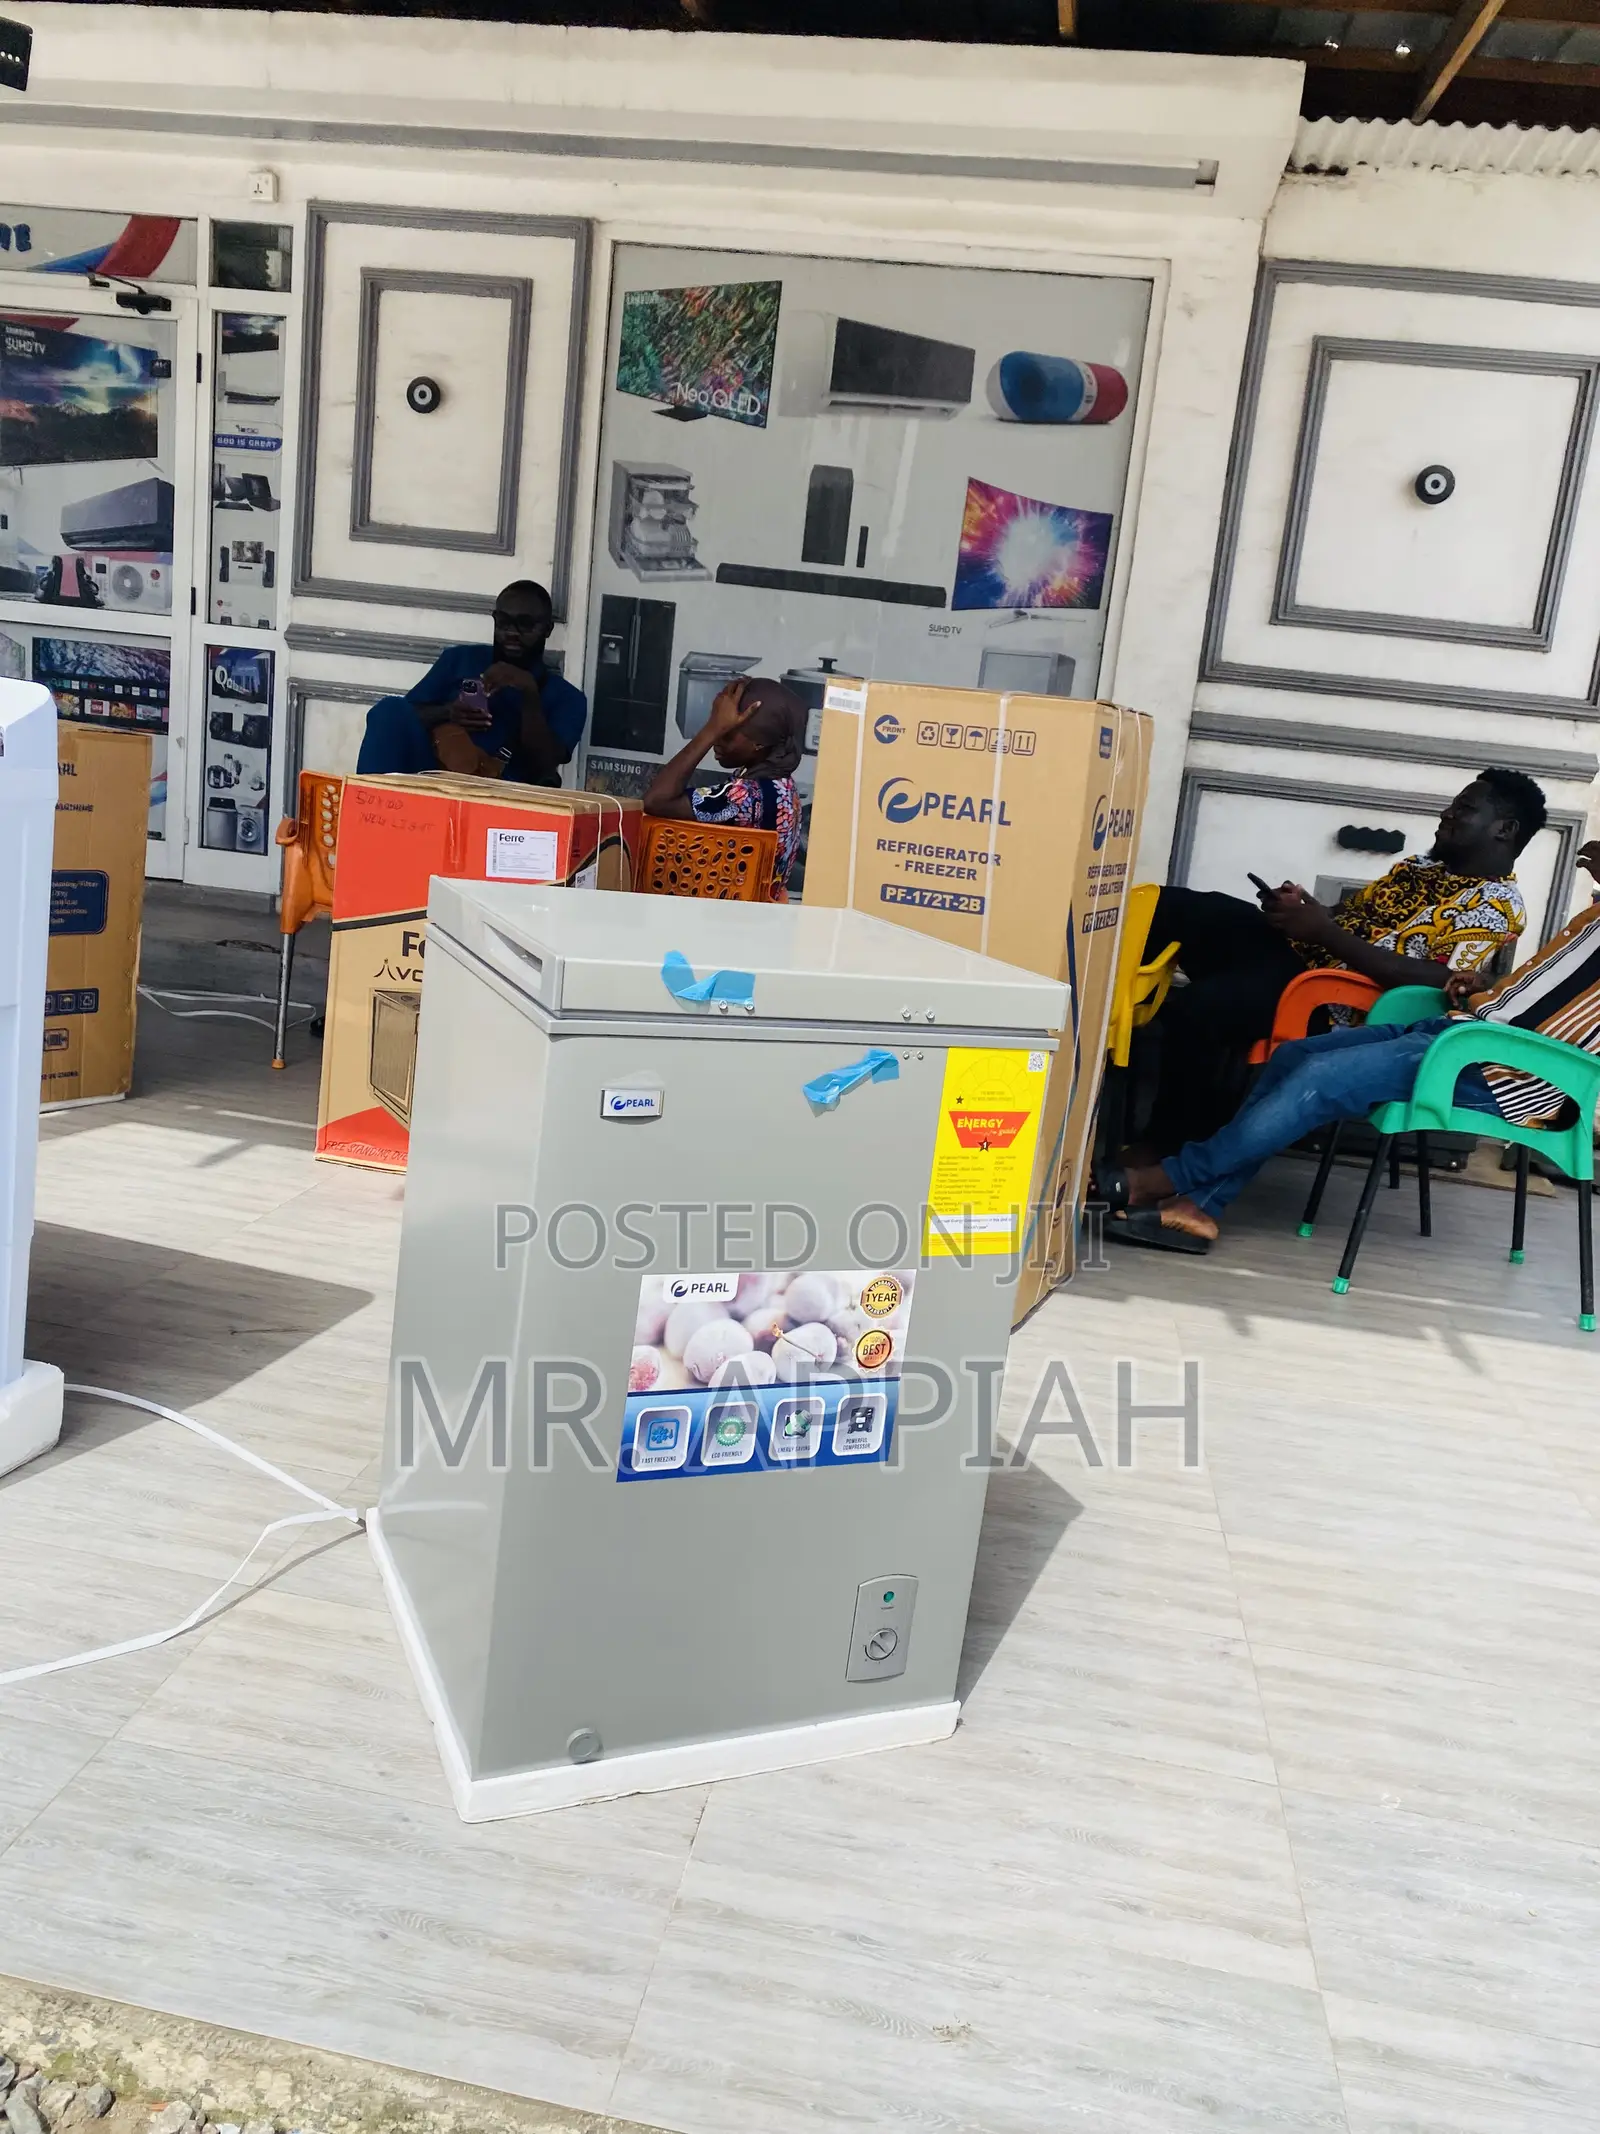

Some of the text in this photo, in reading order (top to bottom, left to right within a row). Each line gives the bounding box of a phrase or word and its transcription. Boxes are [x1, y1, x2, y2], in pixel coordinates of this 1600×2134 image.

[674, 382, 761, 416] Neo QLED
[217, 437, 277, 448] GOD IS GREAT
[928, 623, 951, 634] SUHD
[951, 626, 962, 635] TV
[590, 760, 642, 775] SAMSUNG
[922, 792, 1012, 827] PEARL
[499, 832, 525, 843] Ferre
[875, 838, 1002, 866] REFRIGERATOR
[904, 859, 978, 881] FREEZER
[885, 886, 982, 912] PF-172T-2B
[626, 1098, 655, 1108] PEARL
[957, 1116, 1004, 1131] ENERGY
[347, 1143, 392, 1160] STANDING
[691, 1282, 730, 1294] PEARL
[872, 1292, 898, 1303] YEAR
[862, 1343, 887, 1356] BEST
[843, 1443, 871, 1451] COMPRESSOR
[654, 1455, 677, 1463] FREEZING
[721, 1450, 743, 1458] FRIENDLY
